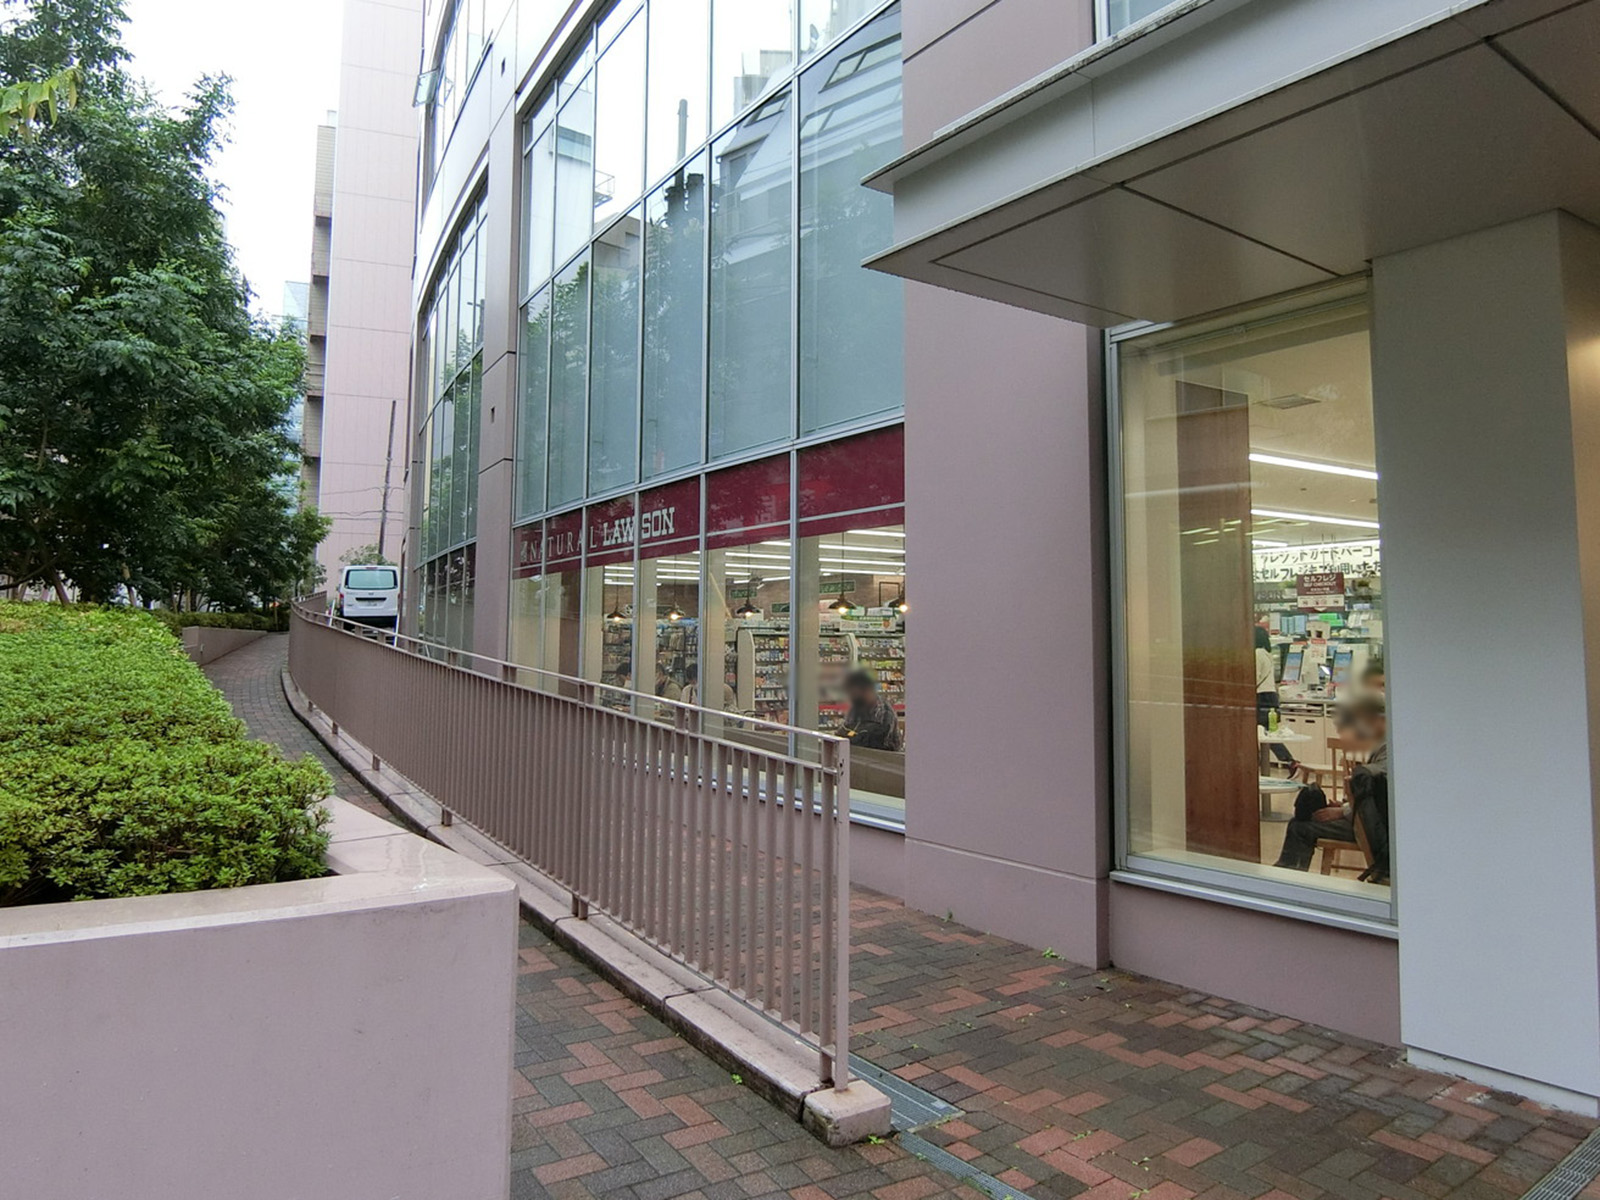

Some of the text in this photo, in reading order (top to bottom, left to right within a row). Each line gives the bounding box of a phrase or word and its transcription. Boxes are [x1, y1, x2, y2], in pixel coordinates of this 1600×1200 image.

[529, 506, 676, 562] NATURAL LAWSON
[1303, 574, 1337, 583] セルフレジ
